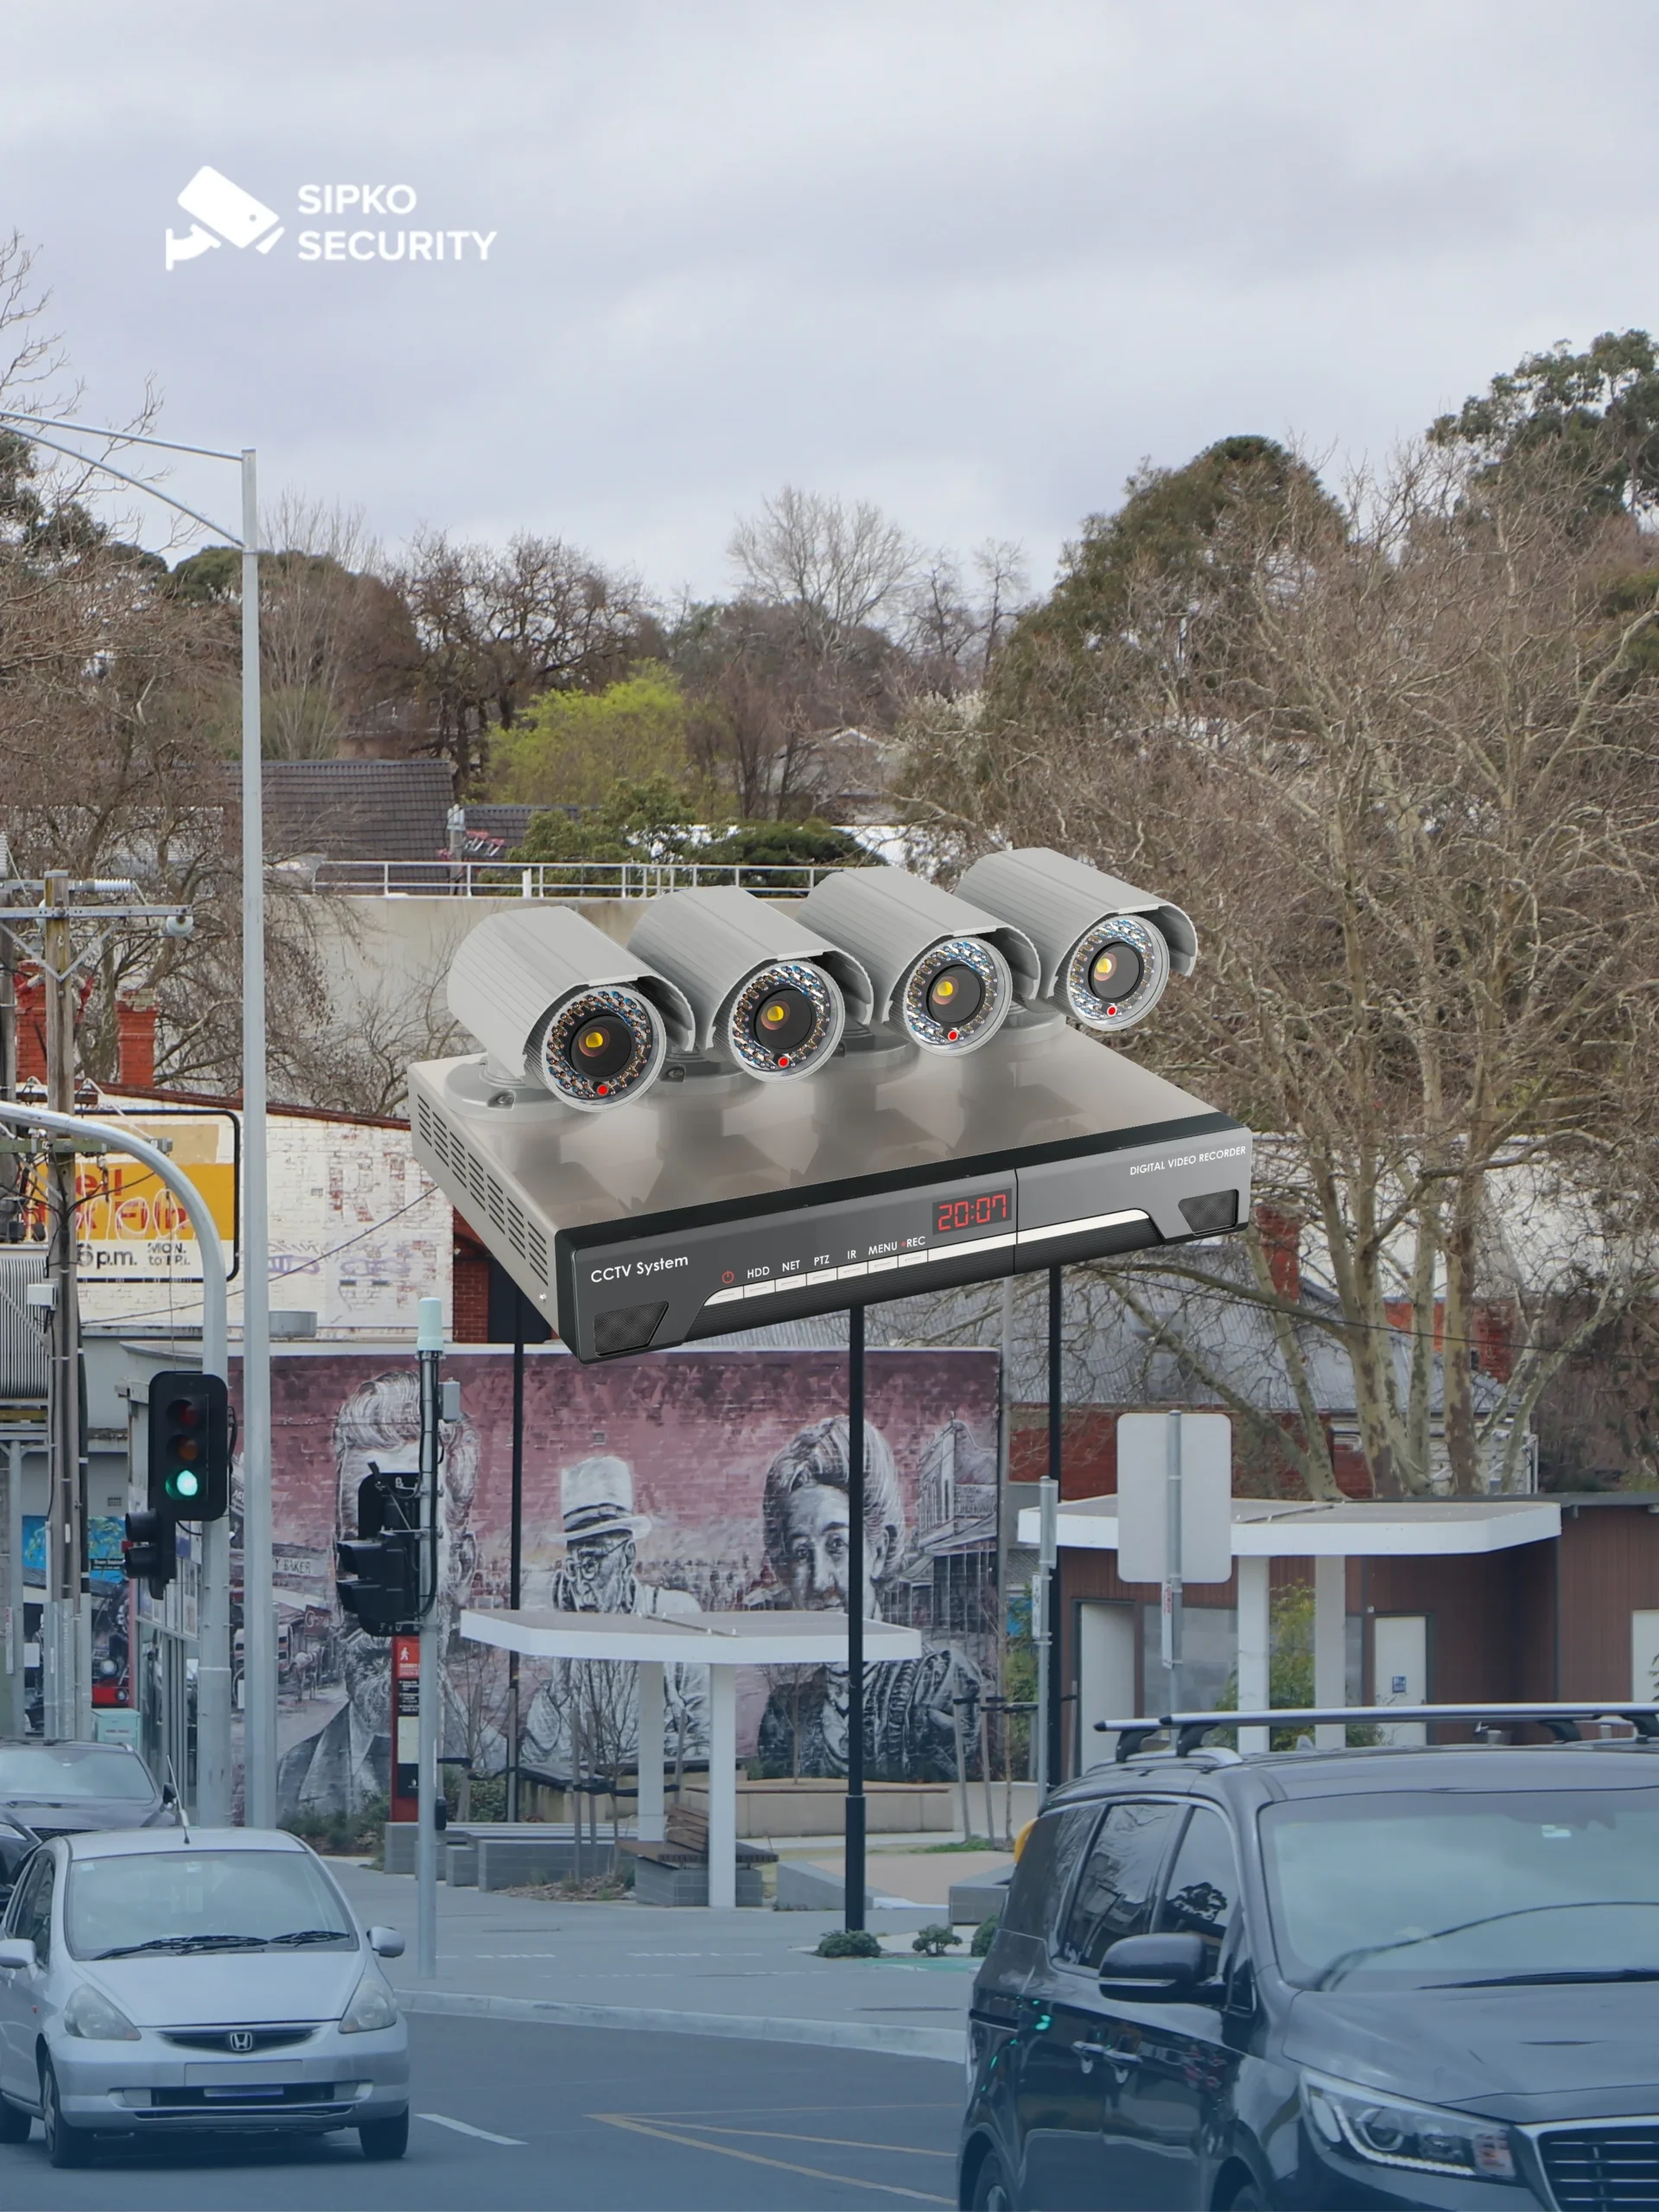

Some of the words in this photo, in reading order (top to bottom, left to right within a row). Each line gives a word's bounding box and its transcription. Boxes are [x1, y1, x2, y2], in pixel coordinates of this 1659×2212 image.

[1129, 1160, 1166, 1176] DIGITAL
[1167, 1154, 1197, 1168] VIDEO
[1198, 1146, 1246, 1163] RECORDER
[938, 1193, 1007, 1231] 20:07
[590, 1263, 632, 1283] CCTV
[636, 1255, 689, 1276] System
[747, 1266, 770, 1279] HDD
[781, 1260, 800, 1272] NET
[813, 1254, 830, 1267] PTZ
[847, 1249, 856, 1260] IR
[868, 1241, 898, 1255] MENU
[906, 1236, 926, 1248] REC
